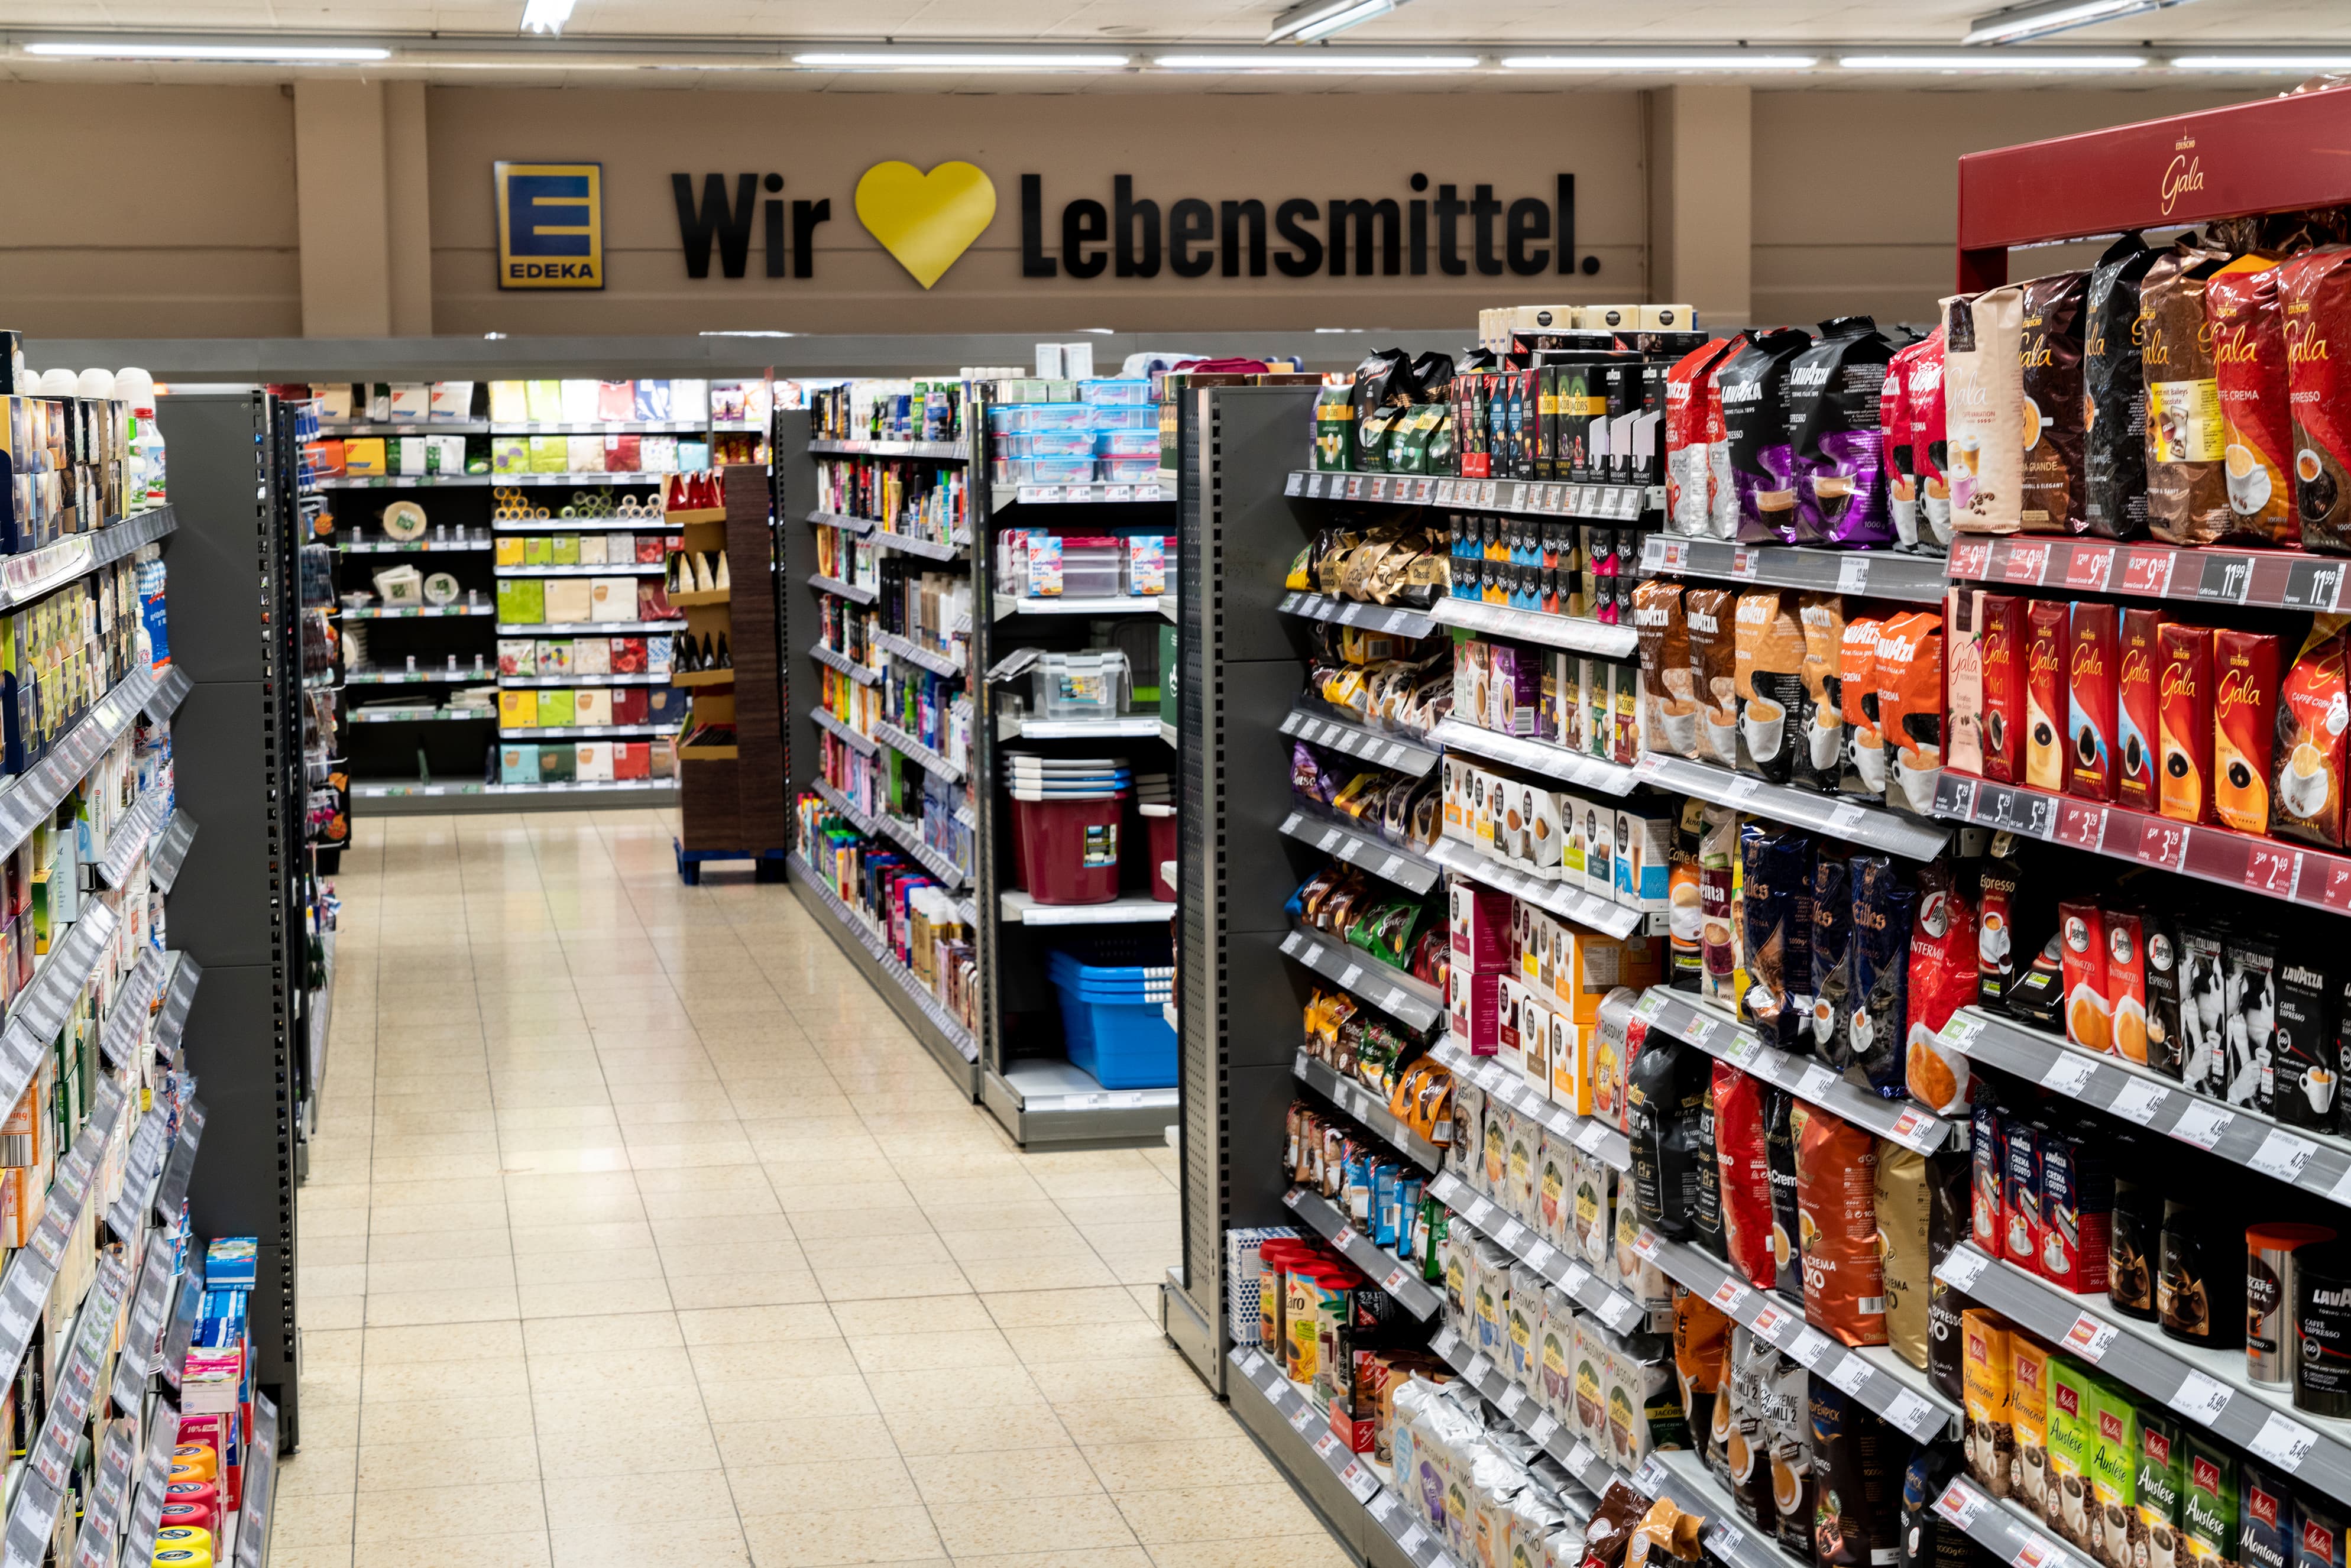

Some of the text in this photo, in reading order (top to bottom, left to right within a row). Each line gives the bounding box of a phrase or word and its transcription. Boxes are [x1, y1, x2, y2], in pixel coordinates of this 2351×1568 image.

[2175, 139, 2195, 150] EDUSCHO
[2161, 154, 2203, 215] Gala
[672, 173, 1600, 278] Wir Lebensmittel.
[510, 264, 593, 278] EDEKA
[2288, 303, 2309, 315] EDUSCHO
[1790, 361, 1831, 385] LAVAZZA
[1722, 380, 1763, 404] LAVAZZA
[2230, 390, 2259, 401] CREMA
[1569, 400, 1588, 412] JACOBS
[1864, 520, 1880, 529] 1000
[1687, 607, 1719, 634] LAVAZZA
[1950, 642, 1978, 685] Gala
[1983, 633, 2010, 676] Gala
[2029, 639, 2059, 684] Gala
[2071, 643, 2103, 688] Gala
[2230, 657, 2249, 668] EDUSCHO
[2121, 649, 2150, 696] Gala
[2161, 662, 2195, 710] Gala
[2219, 669, 2261, 718] Gala
[1616, 698, 1634, 712] JACOBS
[1980, 873, 2015, 892] Espresso
[2148, 972, 2172, 990] ESPRESSO
[2282, 966, 2323, 990] LAVAZZA
[1601, 1021, 1624, 1044] TASSIMO
[2074, 1068, 2093, 1086] 3.79
[2145, 1094, 2164, 1113] 4.69
[2209, 1119, 2228, 1137] 4.99
[2011, 1154, 2029, 1168] CREMA
[2045, 1152, 2066, 1168] LAVAZZA
[2290, 1151, 2311, 1170] 4.79
[2046, 1169, 2065, 1184] CREMA
[1807, 1255, 1837, 1272] CREMA
[1884, 1276, 1909, 1292] CREMA
[1966, 1268, 1980, 1283] 3.99
[2305, 1327, 2340, 1339] ESPRESSO
[1581, 1337, 1607, 1365] TASSIMO
[1613, 1363, 1638, 1393] TASSIMO
[1965, 1367, 1994, 1402] Harmonie
[2011, 1390, 2045, 1426] Harmonie
[2058, 1389, 2077, 1411] Melitta
[2207, 1392, 2227, 1413] 5.99
[1653, 1408, 1683, 1417] JACOBS
[2050, 1417, 2083, 1454] Auslese
[2103, 1417, 2122, 1439] Melitta
[2148, 1436, 2167, 1458] Melitta
[2289, 1440, 2309, 1461] 5.49
[2093, 1444, 2127, 1485] Auslese
[2138, 1465, 2175, 1505] Auslese
[2197, 1464, 2217, 1489] Melitta
[2185, 1494, 2225, 1536] Auslese
[2253, 1495, 2275, 1521] Melitta
[1594, 1524, 1607, 1535] TOP
[2307, 1527, 2329, 1554] Melitta
[1634, 1538, 1647, 1550] TOP
[2239, 1526, 2284, 1567] Montana
